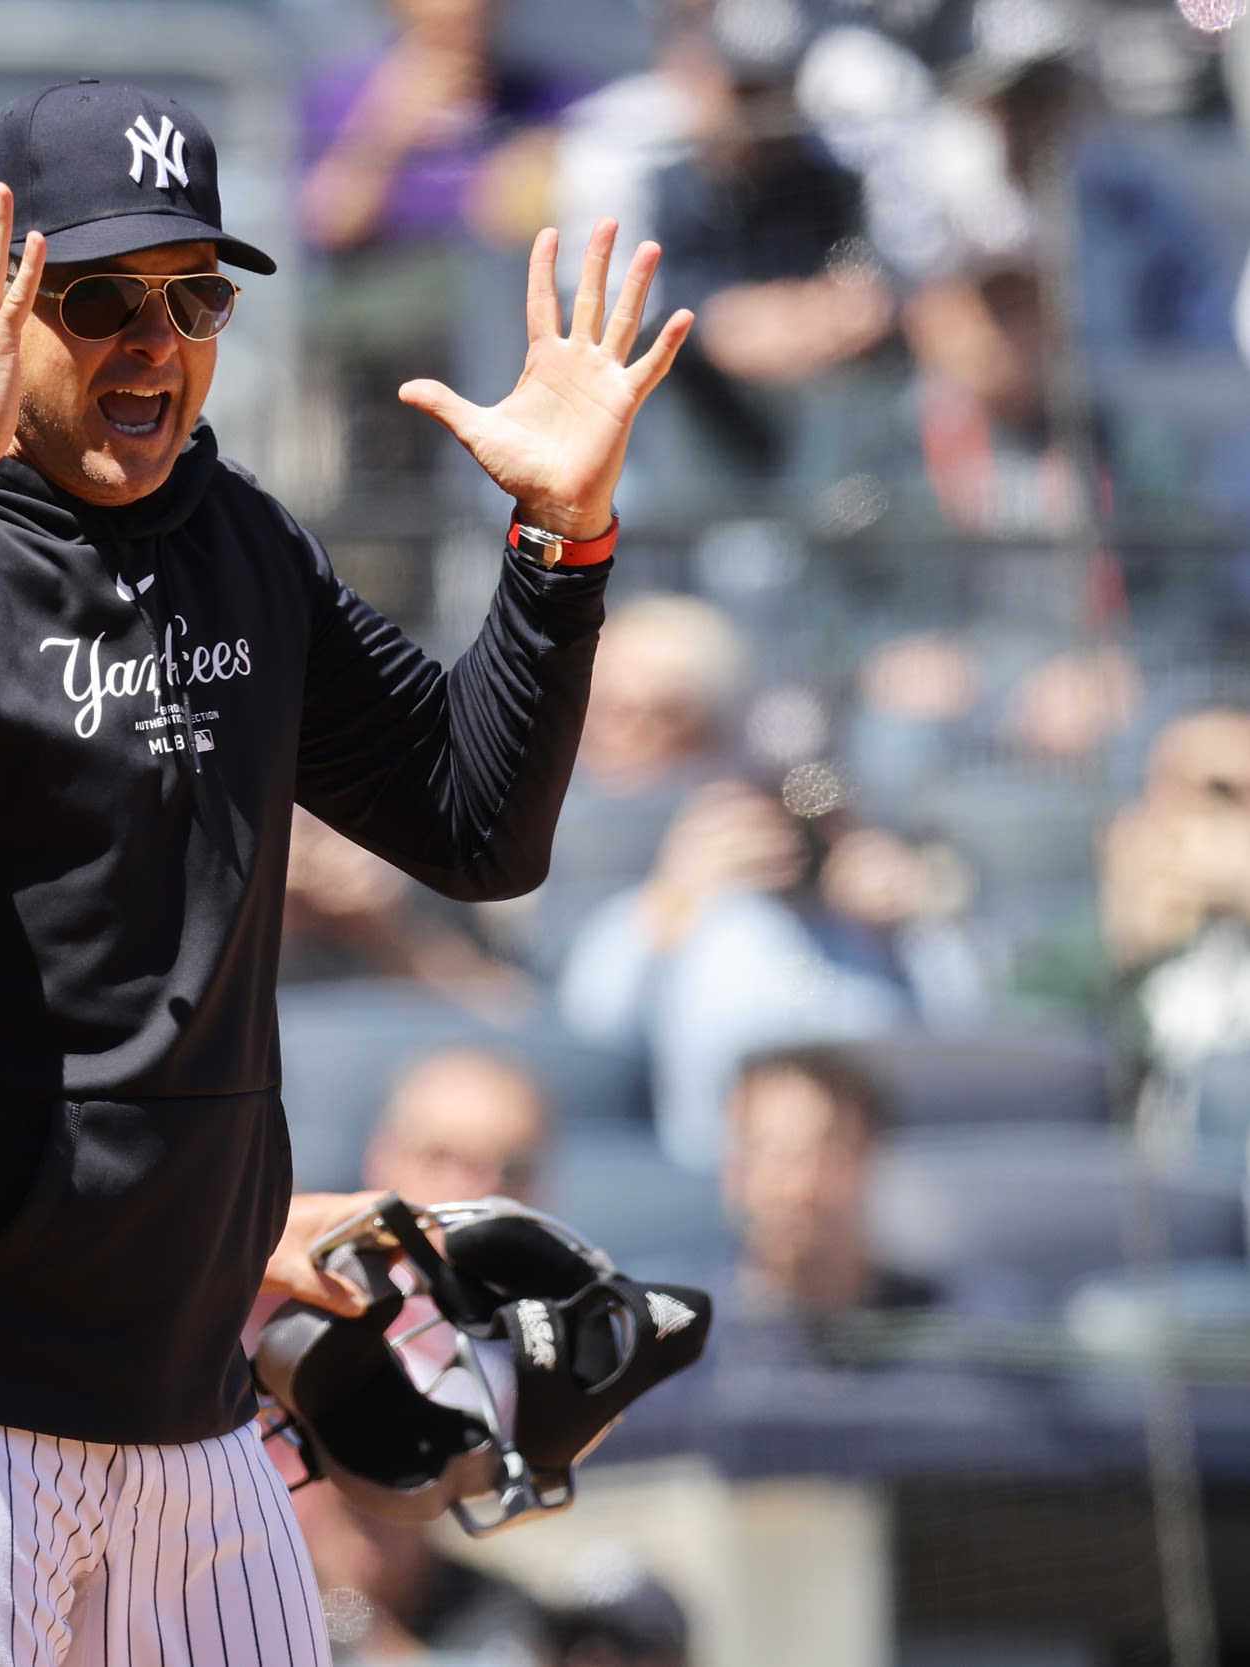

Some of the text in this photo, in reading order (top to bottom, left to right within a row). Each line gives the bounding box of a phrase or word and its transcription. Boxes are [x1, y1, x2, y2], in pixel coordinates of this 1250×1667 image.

[125, 115, 189, 189] NY
[159, 703, 186, 716] BRO
[183, 710, 220, 724] ECTION
[148, 734, 186, 756] MLB
